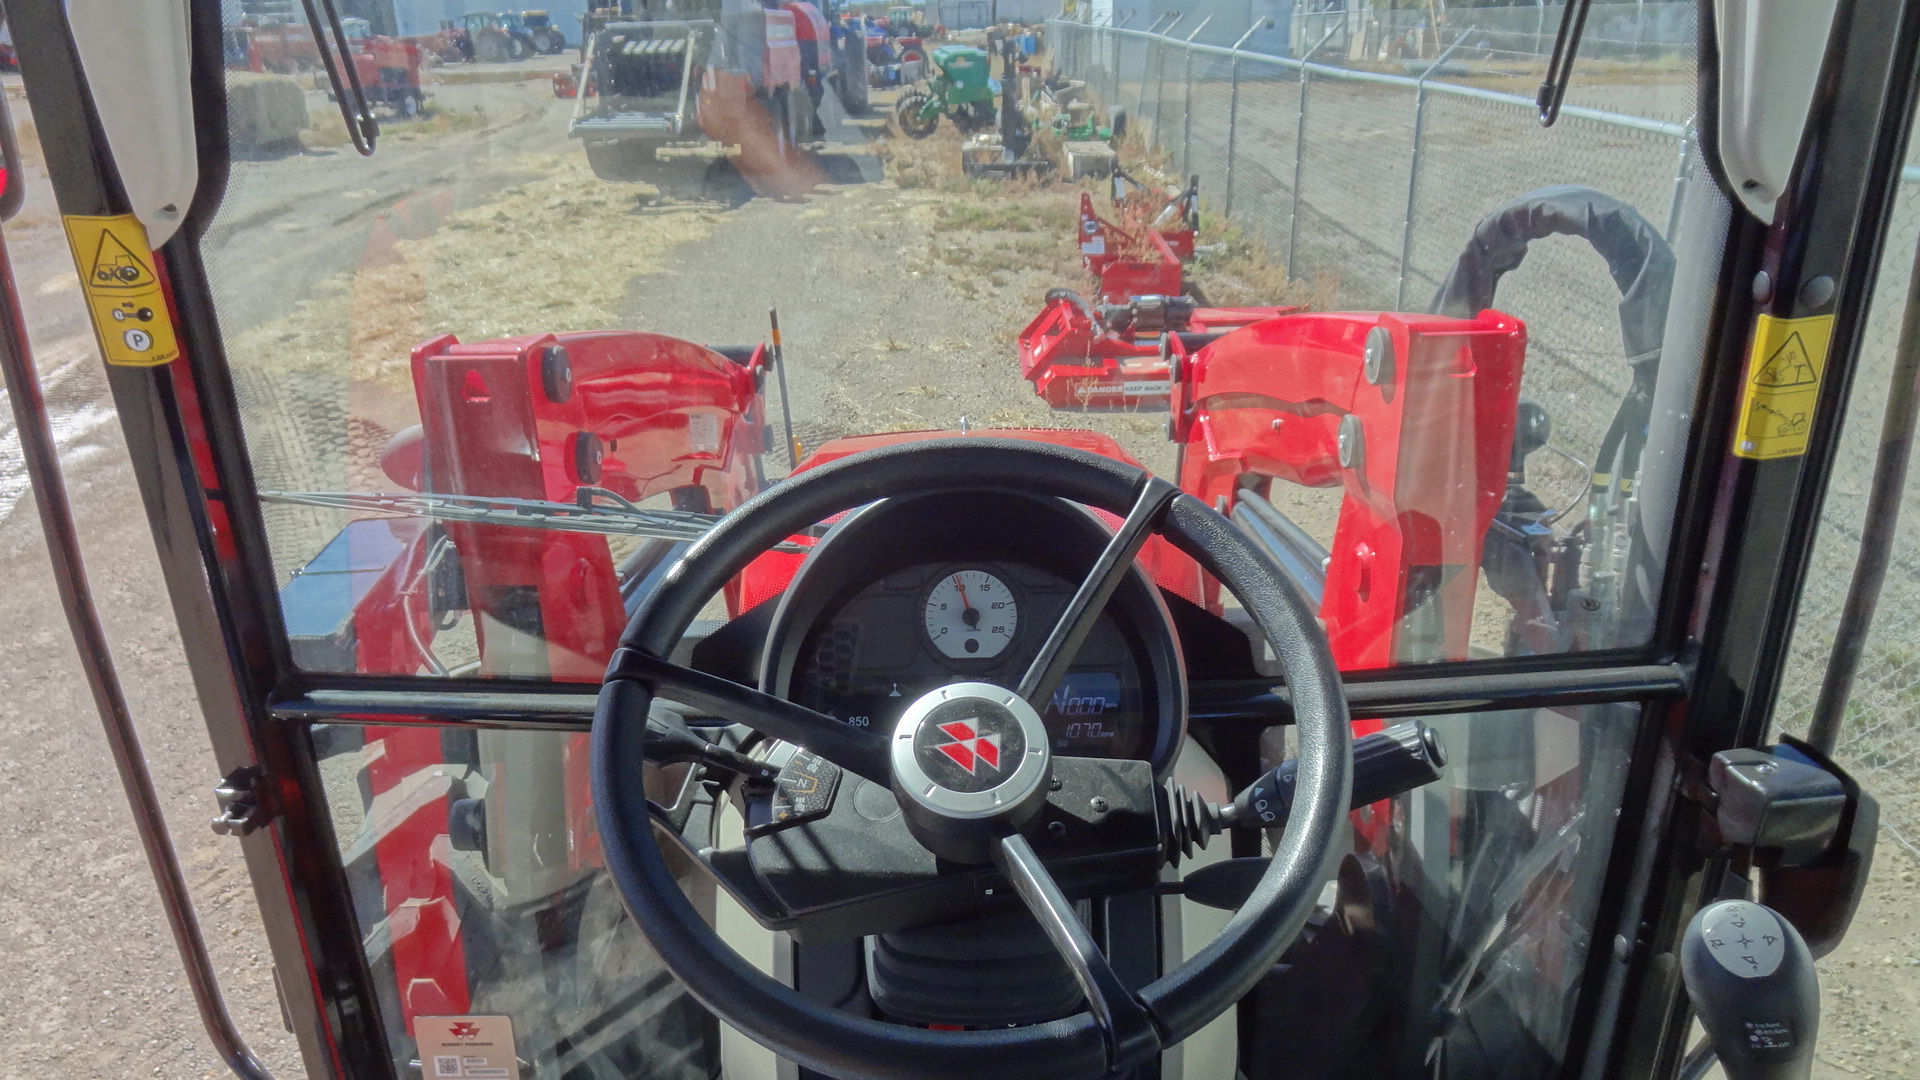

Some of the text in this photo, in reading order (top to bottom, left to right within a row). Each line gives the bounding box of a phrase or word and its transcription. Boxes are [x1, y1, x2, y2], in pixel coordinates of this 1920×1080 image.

[131, 333, 144, 347] P
[1087, 385, 1124, 394] DANGER
[953, 584, 966, 592] 10
[979, 584, 991, 592] 15
[940, 603, 948, 611] 5
[991, 602, 1005, 610] 20
[940, 627, 948, 635] 0
[991, 626, 1005, 634] 25
[848, 716, 869, 727] 850
[1066, 723, 1102, 738] 1070
[797, 778, 808, 788] N
